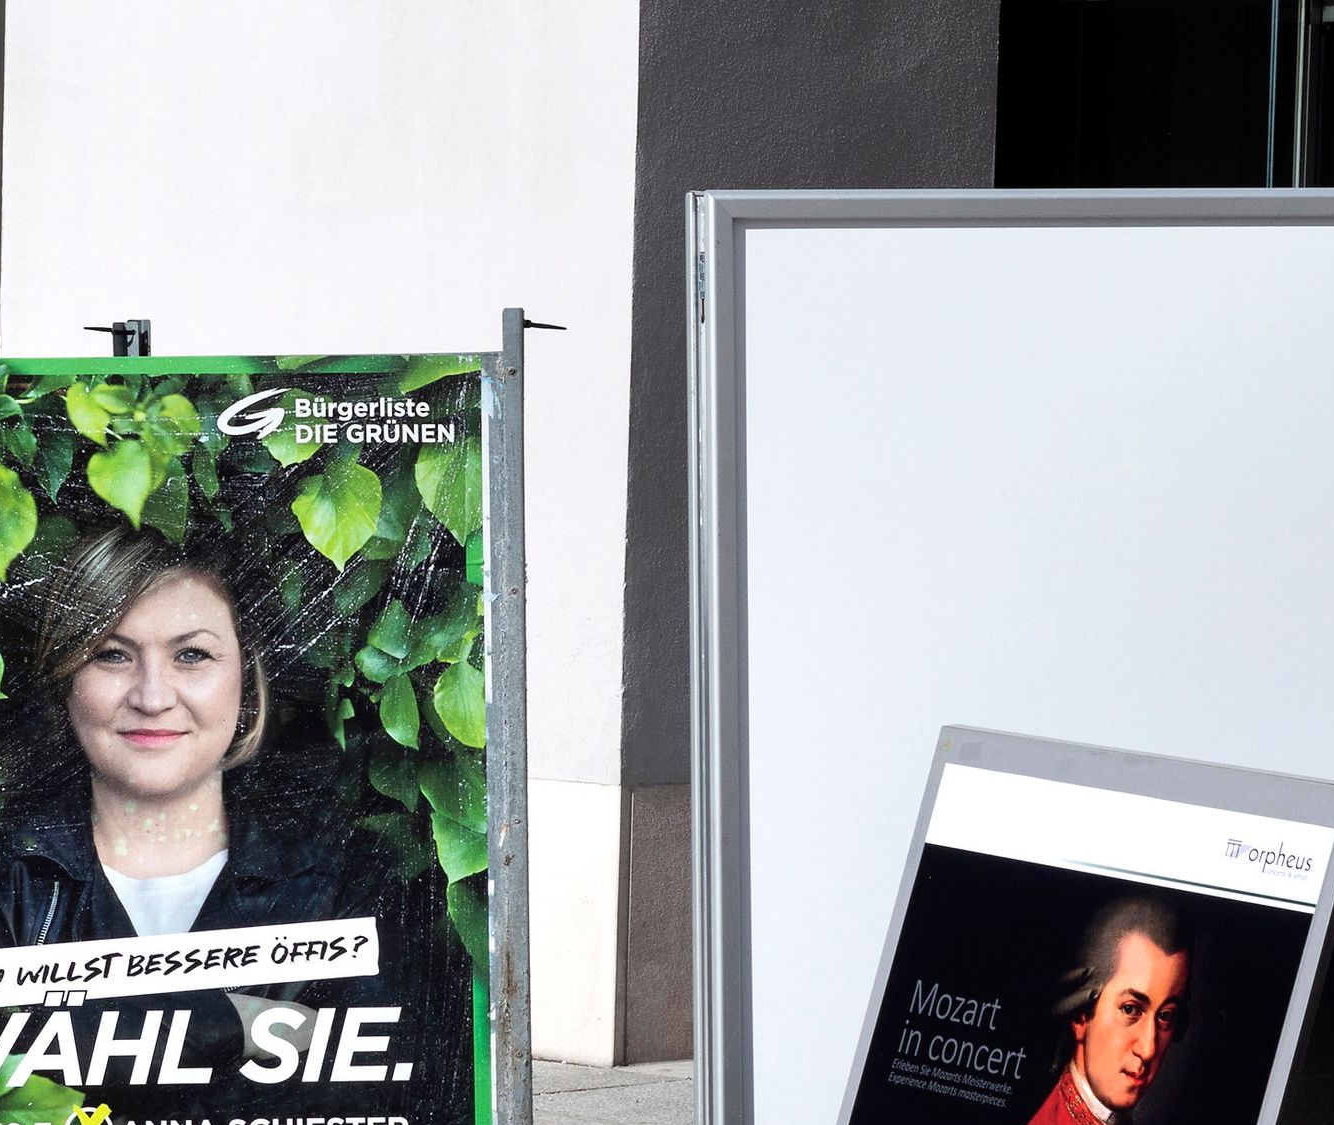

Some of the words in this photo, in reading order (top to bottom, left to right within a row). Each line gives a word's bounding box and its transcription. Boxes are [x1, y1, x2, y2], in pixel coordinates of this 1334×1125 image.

[295, 398, 430, 422] Bürgerliste
[296, 424, 338, 443] DIE
[346, 419, 454, 443] GRÜNEN
[17, 953, 122, 984] WILLST
[127, 943, 260, 977] BESSERE
[270, 934, 369, 965] ÖFFIS?
[909, 979, 1002, 1031] Mozart
[239, 1006, 414, 1084] SIE.
[898, 1019, 922, 1057] in
[928, 1035, 1027, 1080] concert
[888, 1071, 927, 1089] Experience
[927, 1080, 958, 1097] Mozarts
[957, 1088, 1007, 1108] masterpieces.
[891, 1057, 919, 1073] Erleben
[919, 1064, 931, 1076] Sie
[931, 1066, 962, 1083] Mozarts
[961, 1073, 1013, 1095] Meisterwerke.
